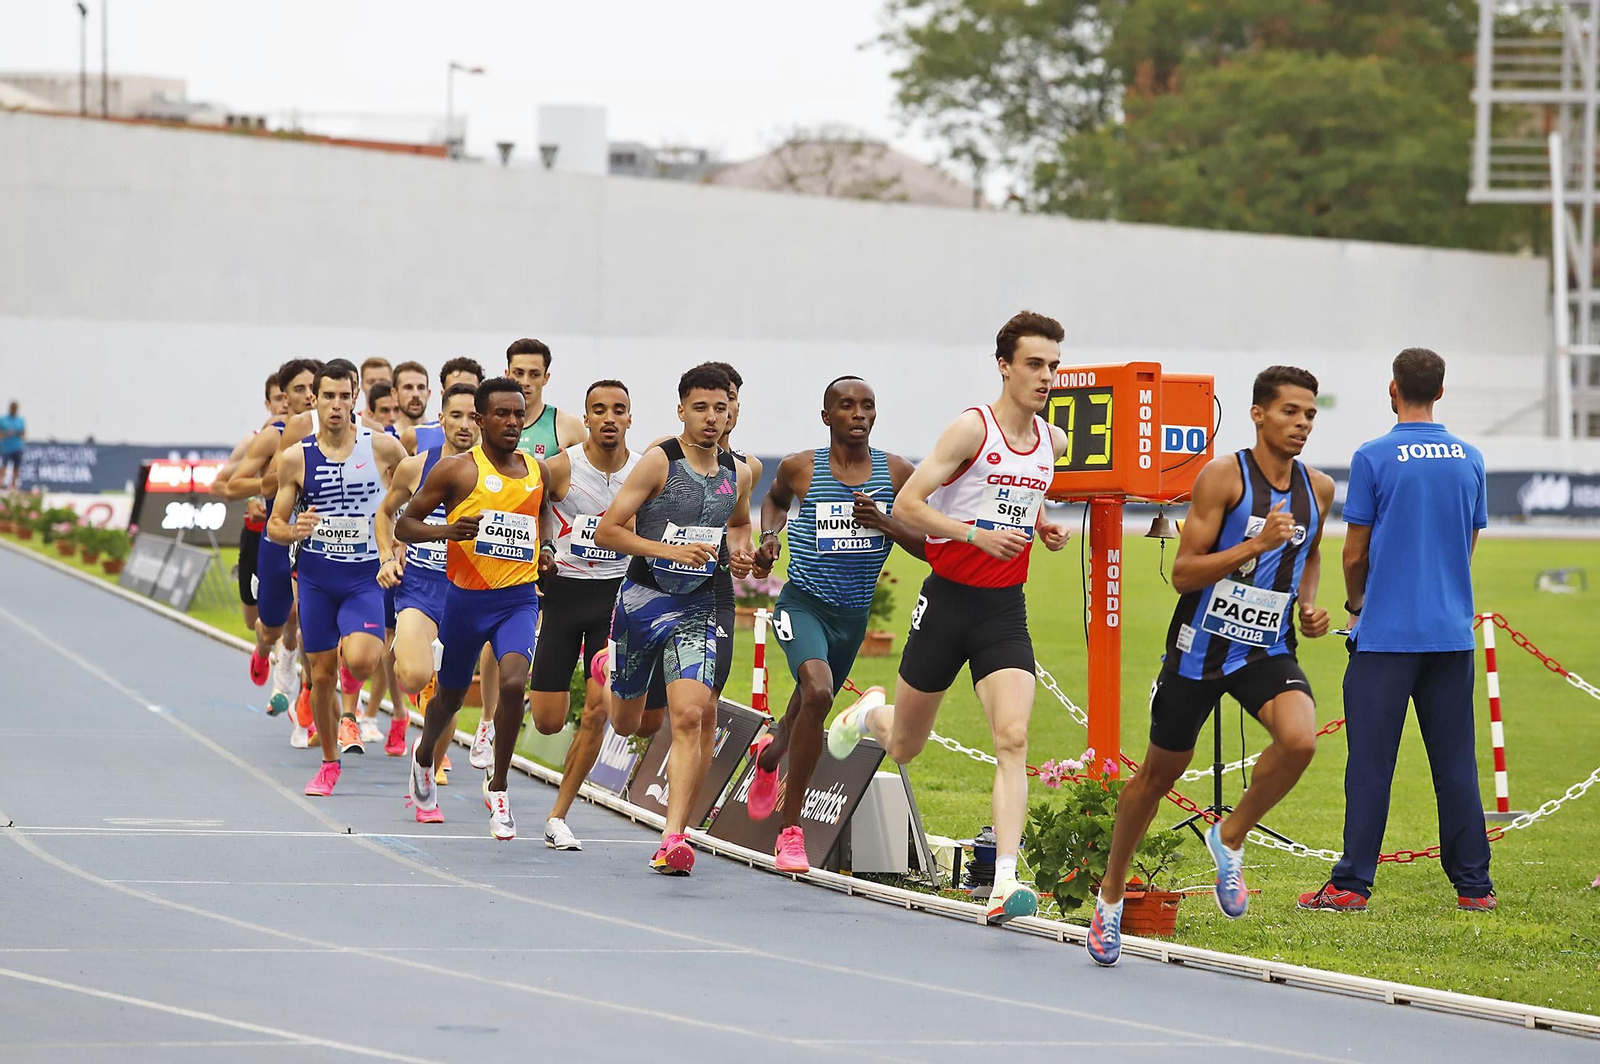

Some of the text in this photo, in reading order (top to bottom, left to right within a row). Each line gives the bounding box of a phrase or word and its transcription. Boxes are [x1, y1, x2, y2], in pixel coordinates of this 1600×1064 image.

[1052, 372, 1096, 388] MONDO
[1139, 390, 1152, 470] MONDO
[1165, 427, 1205, 452] DO
[1397, 443, 1466, 462] Joma
[987, 474, 1047, 492] GOLAZO
[997, 503, 1028, 518] SISK
[1010, 516, 1021, 525] 15
[317, 528, 359, 538] GOMEZ
[485, 525, 530, 541] GADISA
[851, 529, 857, 537] 9
[322, 543, 355, 553] Joma
[505, 537, 515, 545] 13
[831, 538, 872, 551] Joma
[488, 544, 524, 558] Joma
[582, 547, 617, 559] Joma
[1106, 549, 1120, 627] MONDO
[1211, 597, 1280, 628] PACER
[1218, 621, 1264, 643] Joma
